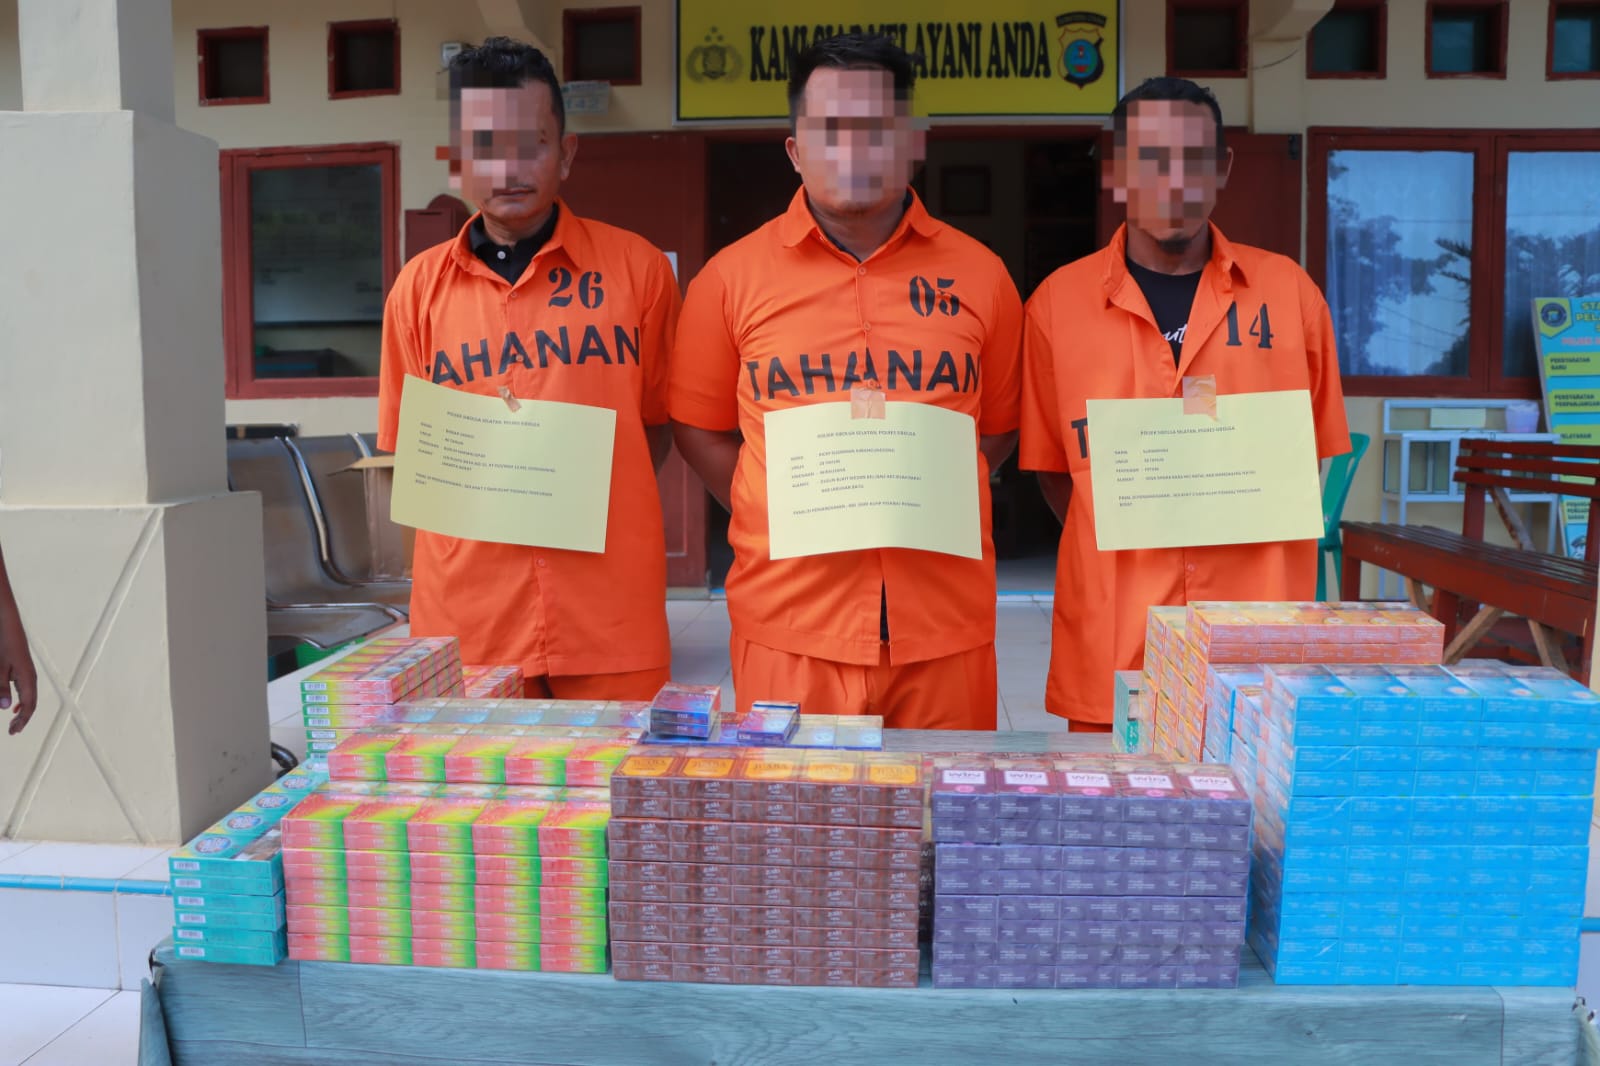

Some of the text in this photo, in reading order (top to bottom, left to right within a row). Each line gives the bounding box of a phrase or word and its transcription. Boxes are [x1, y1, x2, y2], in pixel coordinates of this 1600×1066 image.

[985, 20, 1052, 79] ANDA
[548, 266, 605, 309] 26
[909, 275, 960, 317] 05
[1226, 301, 1274, 349] 14
[1575, 312, 1600, 322] PEL
[425, 324, 640, 385] AHANAN
[746, 347, 981, 401] TAHANAN
